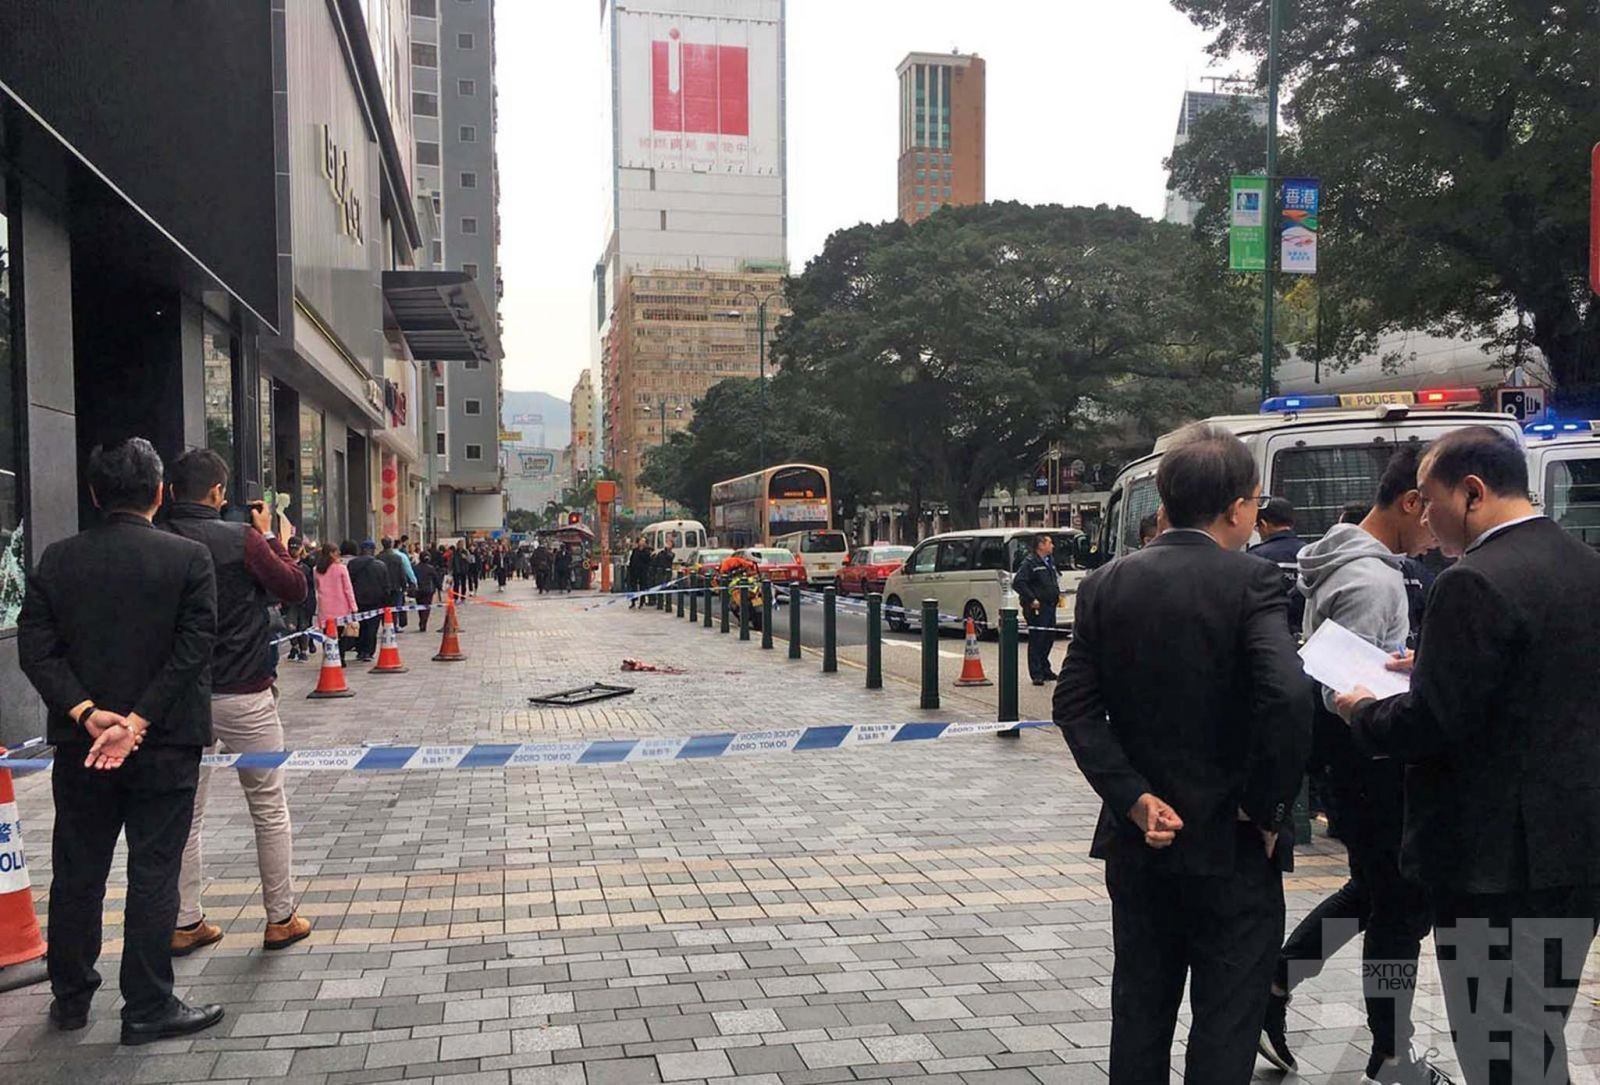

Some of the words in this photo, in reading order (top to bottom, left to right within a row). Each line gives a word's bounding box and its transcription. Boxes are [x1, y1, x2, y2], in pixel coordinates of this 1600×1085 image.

[1285, 188, 1316, 204] 香港
[1357, 394, 1397, 405] POLICE
[0, 849, 27, 873] OLI
